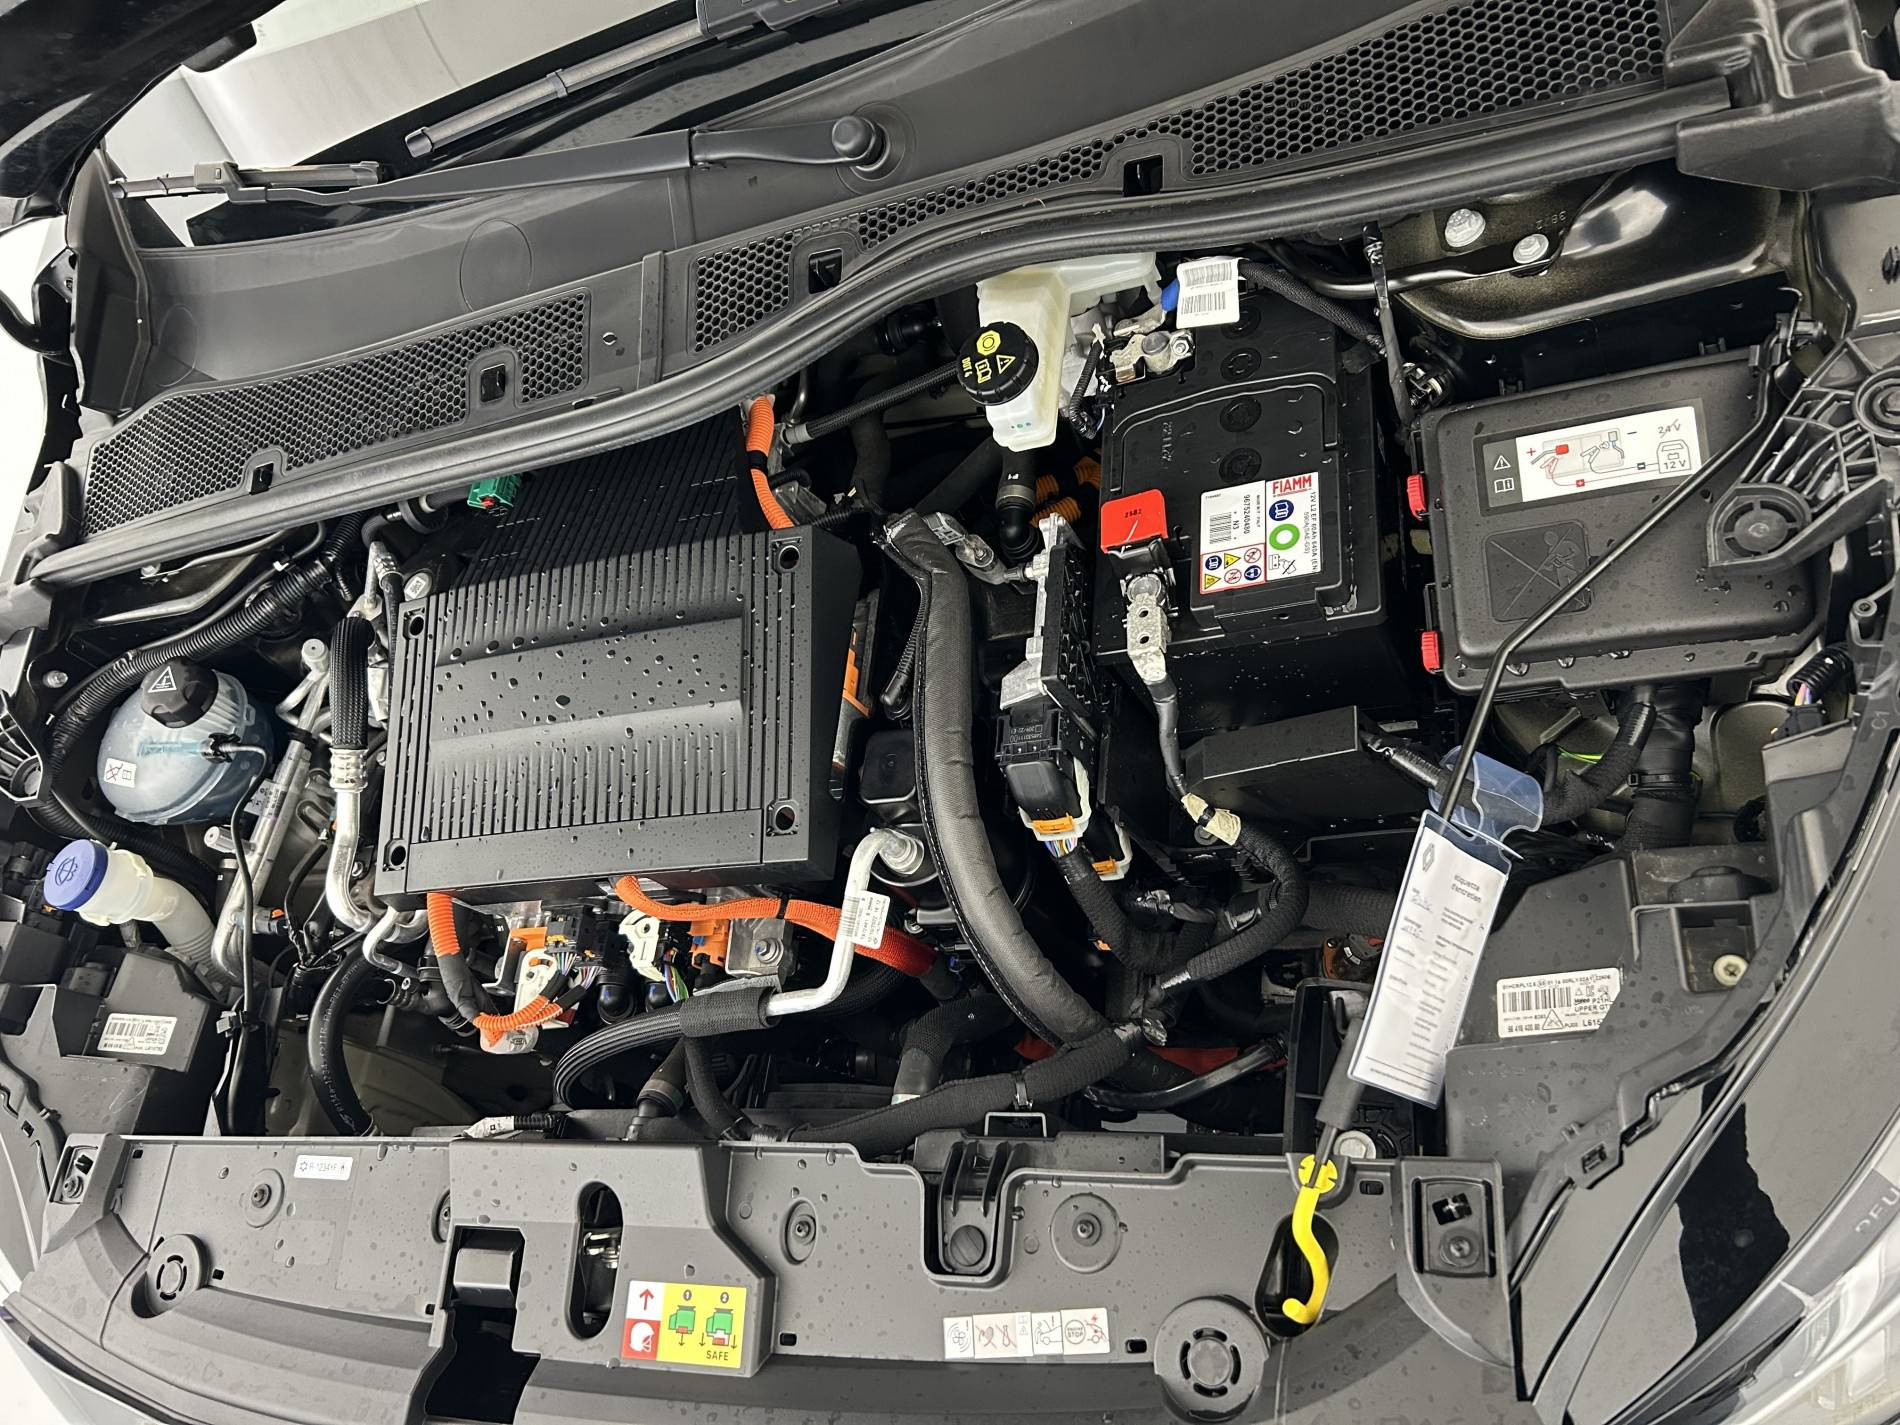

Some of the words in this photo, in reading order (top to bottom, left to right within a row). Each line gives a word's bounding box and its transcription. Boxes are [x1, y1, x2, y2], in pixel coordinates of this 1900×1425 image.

[961, 356, 973, 372] DOT
[1664, 460, 1677, 470] 12
[1678, 459, 1687, 468] V
[1272, 475, 1312, 495] FIAMM
[1310, 503, 1317, 513] L2
[1232, 520, 1240, 530] N3
[1574, 1004, 1598, 1012] UPPER
[705, 1350, 729, 1361] SAFE
